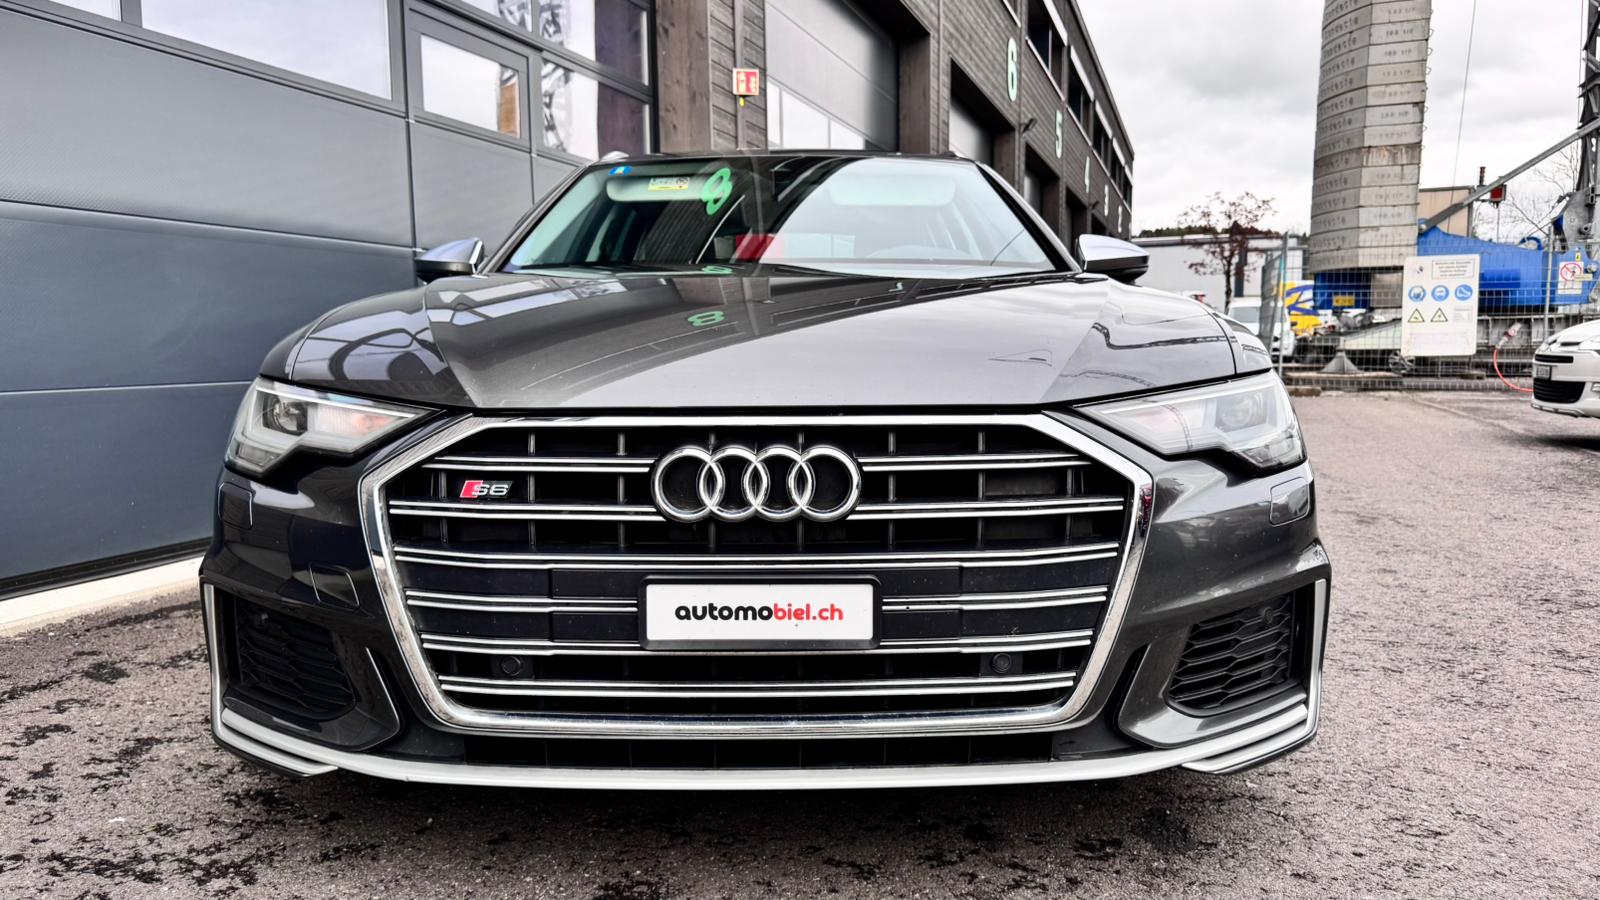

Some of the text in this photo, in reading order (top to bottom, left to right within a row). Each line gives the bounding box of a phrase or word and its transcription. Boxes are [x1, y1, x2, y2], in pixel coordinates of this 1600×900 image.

[1007, 37, 1018, 102] 6
[1055, 109, 1063, 159] 5
[471, 484, 509, 496] S6
[674, 602, 844, 621] automobiel.ch
